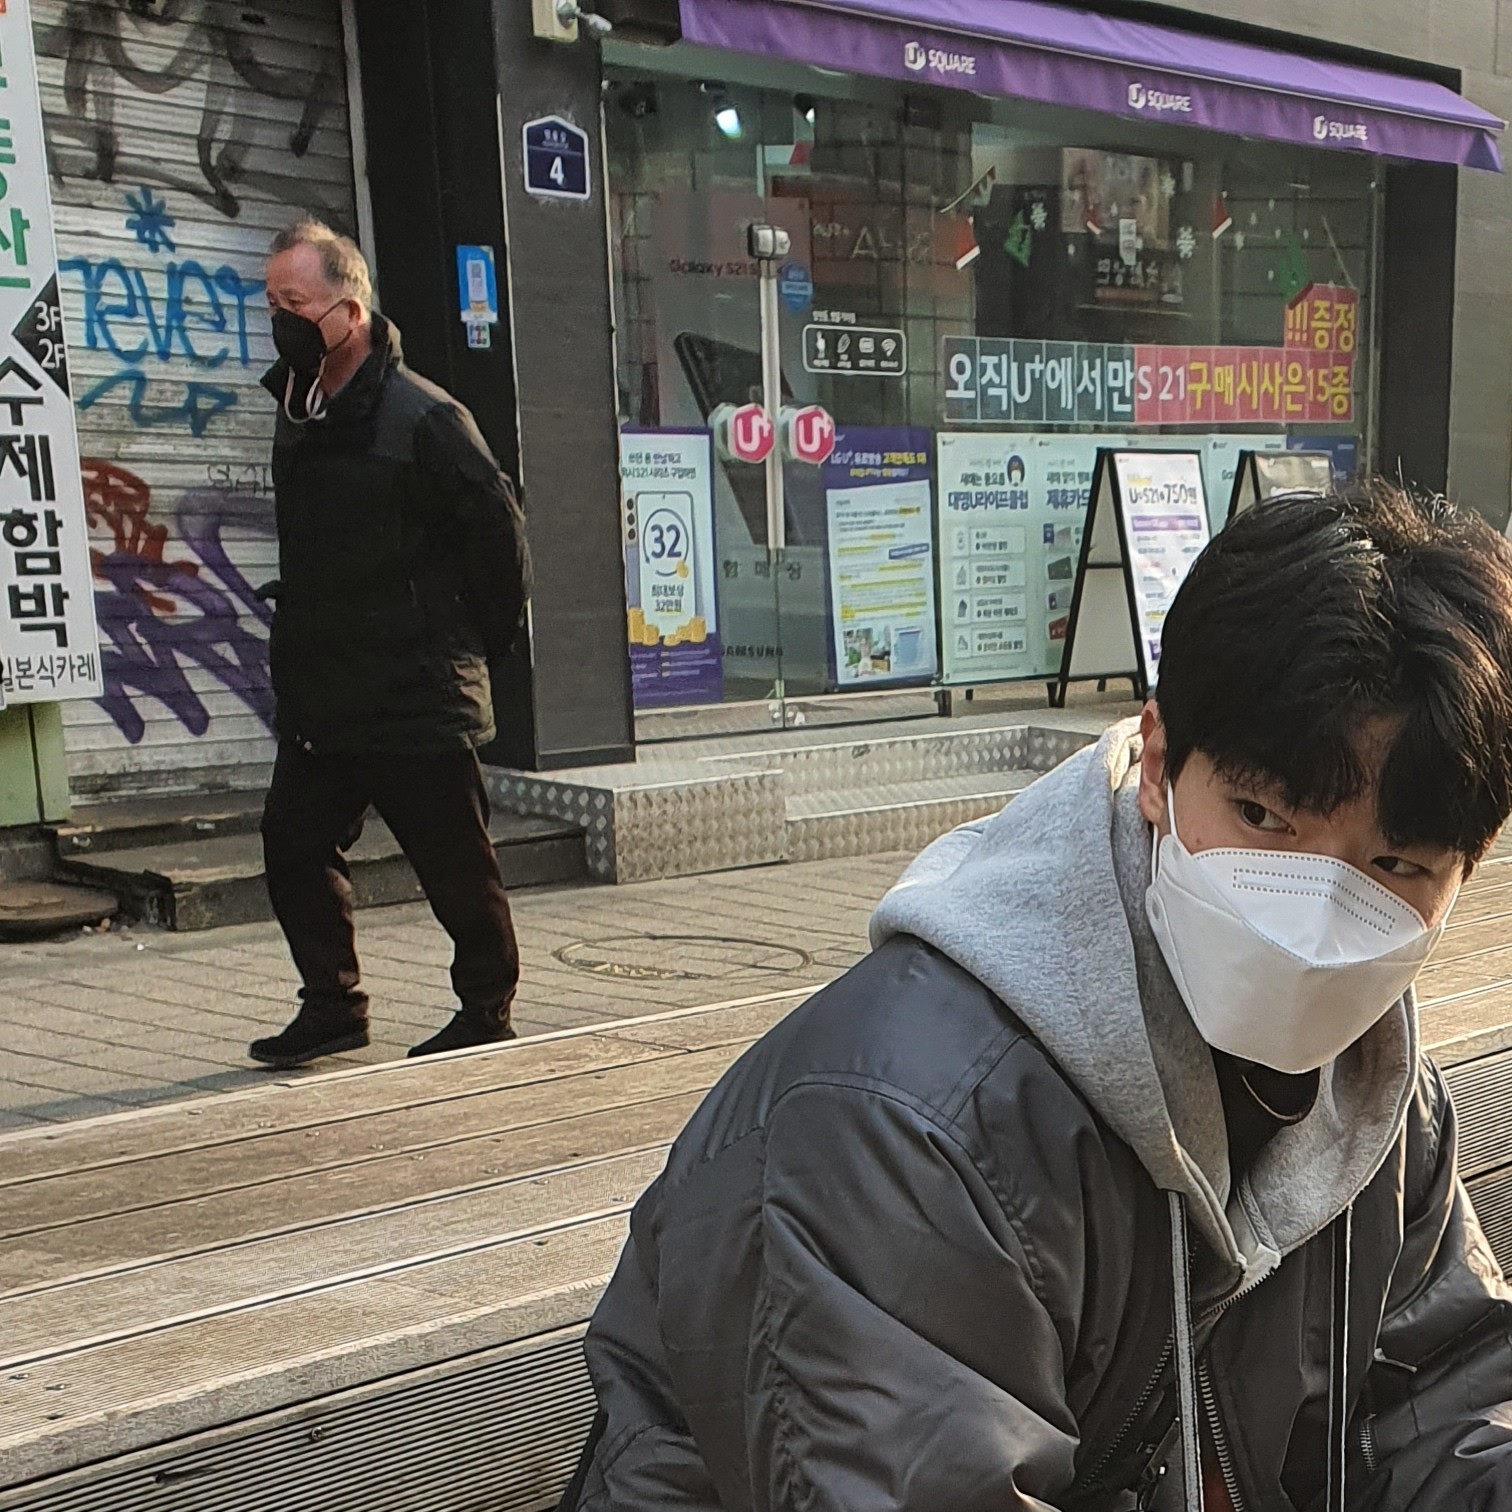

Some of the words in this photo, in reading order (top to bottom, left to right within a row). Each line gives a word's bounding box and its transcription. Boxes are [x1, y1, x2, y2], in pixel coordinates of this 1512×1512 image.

[928, 49, 976, 74] SQUARE
[1147, 90, 1192, 112] SQUARE
[1329, 121, 1368, 140] SQUARE
[549, 155, 565, 187] 4
[34, 301, 60, 332] 3F
[39, 339, 65, 370] 2F
[736, 414, 772, 453] U+
[799, 415, 832, 453] U+
[650, 523, 682, 559] 32
